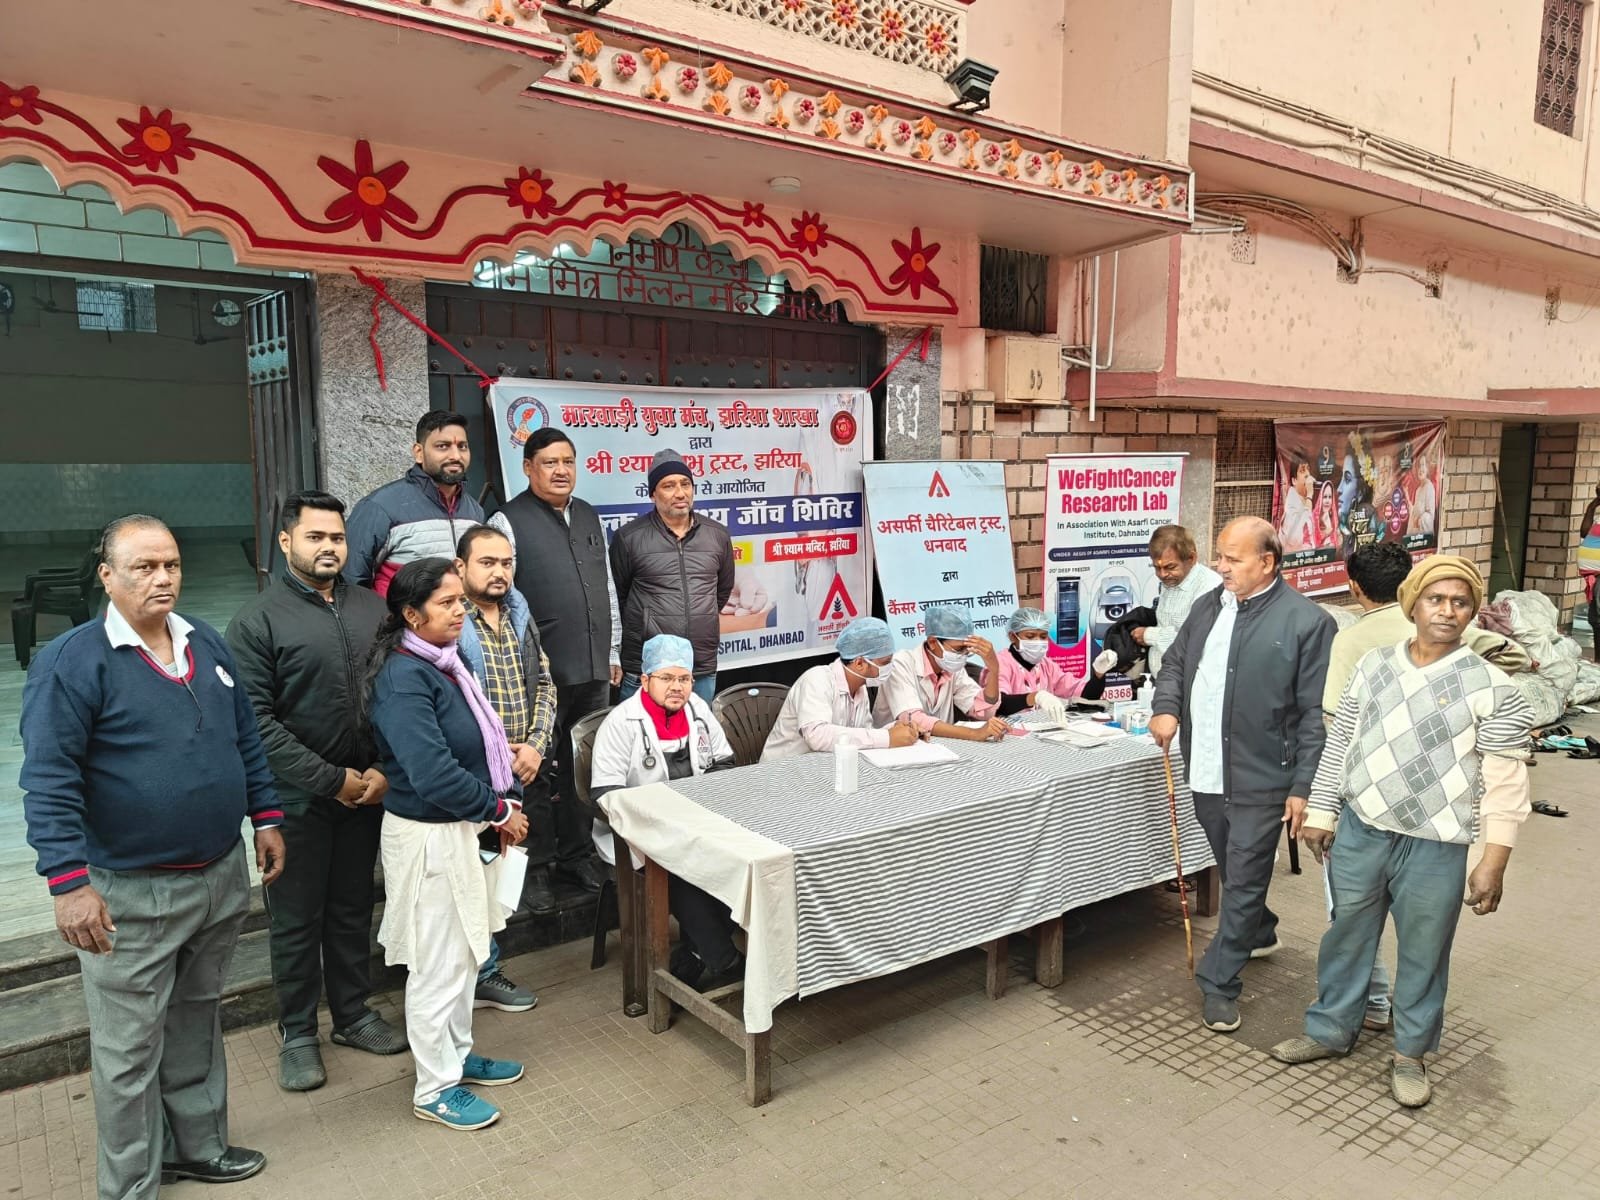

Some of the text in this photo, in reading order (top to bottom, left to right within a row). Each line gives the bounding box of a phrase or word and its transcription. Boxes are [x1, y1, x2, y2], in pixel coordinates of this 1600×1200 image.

[560, 397, 638, 432] मारवाड़ी
[642, 406, 676, 436] युवा
[679, 400, 714, 431] मंच,
[718, 400, 770, 428] झरिया
[773, 406, 819, 427] शाखा
[689, 436, 712, 450] द्वारा
[586, 451, 612, 474] श्री
[710, 454, 748, 474] ट्रस्ट,
[754, 448, 802, 471] झरिया
[702, 481, 713, 495] से
[716, 479, 765, 494] आयोजित
[1058, 468, 1176, 491] WeFightCancer
[792, 497, 855, 521] शिविर
[1062, 491, 1168, 513] Research Lab
[877, 513, 1005, 534] असर्फी चैरिटेबल ट्रस्ट,
[1057, 517, 1172, 530] In Association With Asarfi Cancer
[1084, 530, 1117, 539] Institute,
[924, 538, 966, 553] धनवाद
[942, 571, 959, 582] द्वारा
[888, 599, 916, 615] कैंसर
[901, 626, 916, 638] सह
[718, 630, 804, 656] SPITAL, DHANBAD
